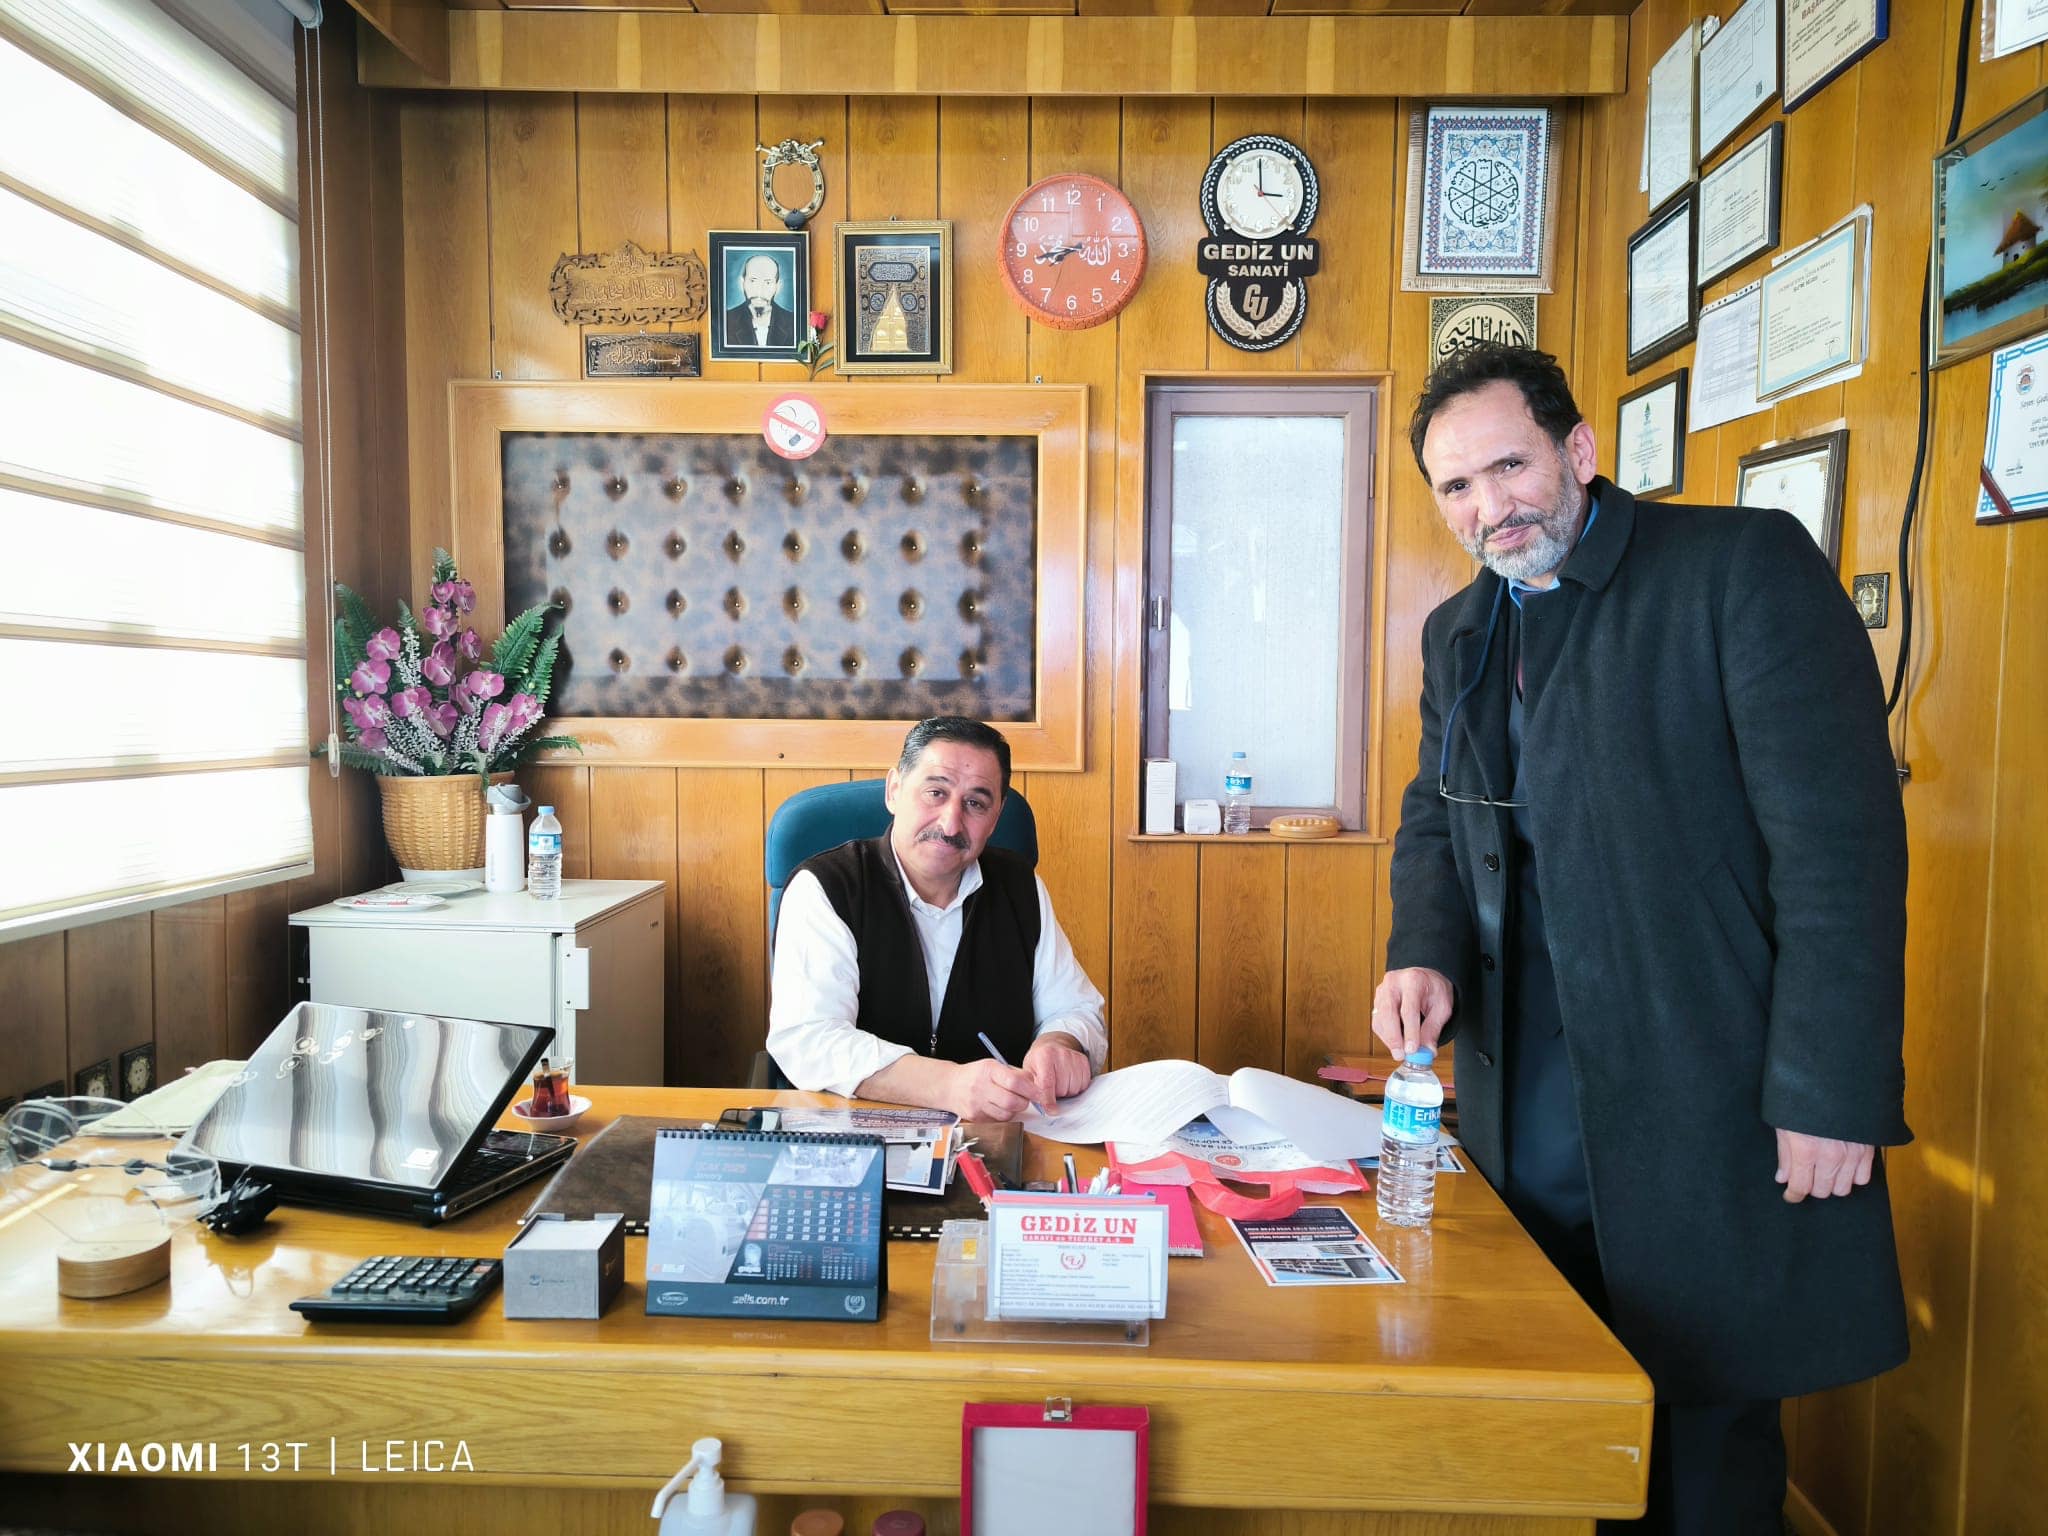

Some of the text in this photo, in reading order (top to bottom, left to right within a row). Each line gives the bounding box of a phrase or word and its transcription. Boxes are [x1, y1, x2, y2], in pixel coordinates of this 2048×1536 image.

[1043, 197, 1055, 212] 11
[1066, 190, 1081, 205] 12
[1096, 197, 1103, 212] 1
[1023, 217, 1039, 232] 10
[1111, 216, 1122, 231] 2
[1016, 243, 1027, 257] 9
[1118, 243, 1129, 258] 3
[1203, 241, 1314, 260] GEDİZ UN
[1023, 269, 1033, 283] 8
[1110, 269, 1121, 284] 4
[1228, 262, 1289, 277] SANAYİ
[1041, 288, 1052, 303] 7
[1066, 295, 1077, 310] 6
[1092, 288, 1103, 303] 5
[1020, 1213, 1137, 1234] GEDİZ UN
